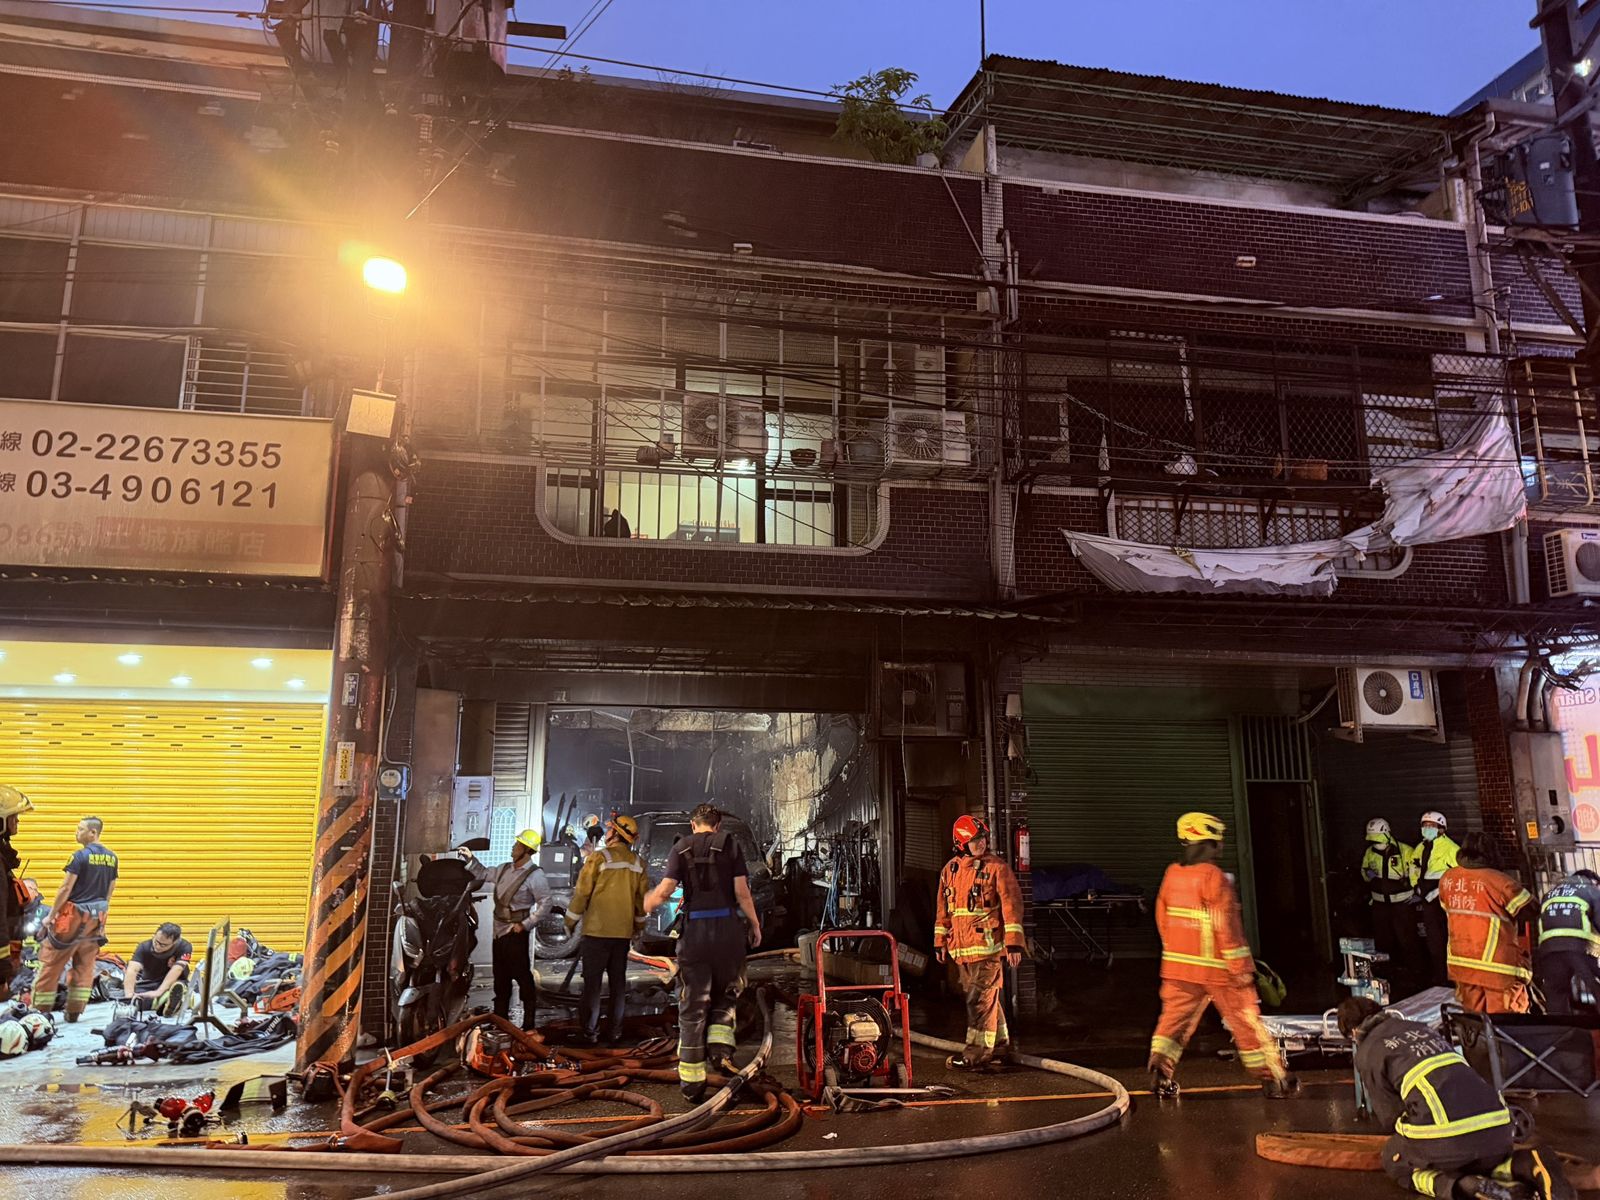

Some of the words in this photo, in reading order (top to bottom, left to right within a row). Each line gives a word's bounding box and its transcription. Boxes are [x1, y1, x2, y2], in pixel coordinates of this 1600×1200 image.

[0, 430, 22, 452] 線
[31, 429, 282, 469] 02-22673355
[26, 470, 276, 509] 03-4906121
[1443, 878, 1484, 893] 新北市
[1449, 895, 1476, 910] 消防
